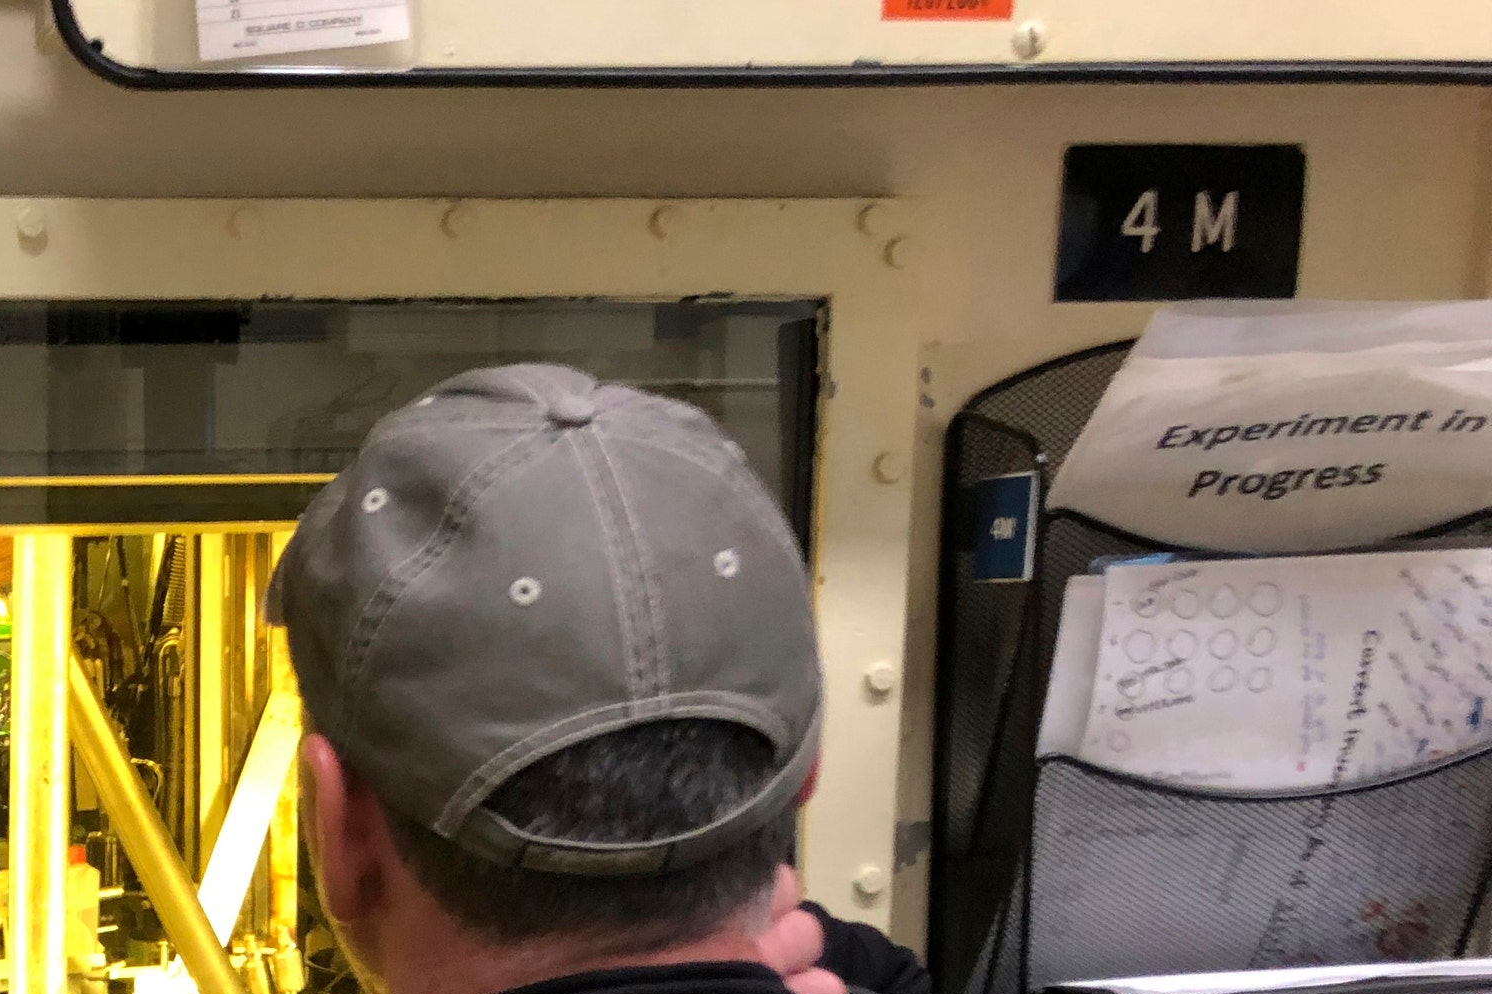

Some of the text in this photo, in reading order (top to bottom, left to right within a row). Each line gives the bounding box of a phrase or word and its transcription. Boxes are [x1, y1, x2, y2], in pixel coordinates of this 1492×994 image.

[1120, 188, 1240, 254] 4 M
[1156, 410, 1488, 451] Experiment in
[1186, 462, 1389, 501] Progress
